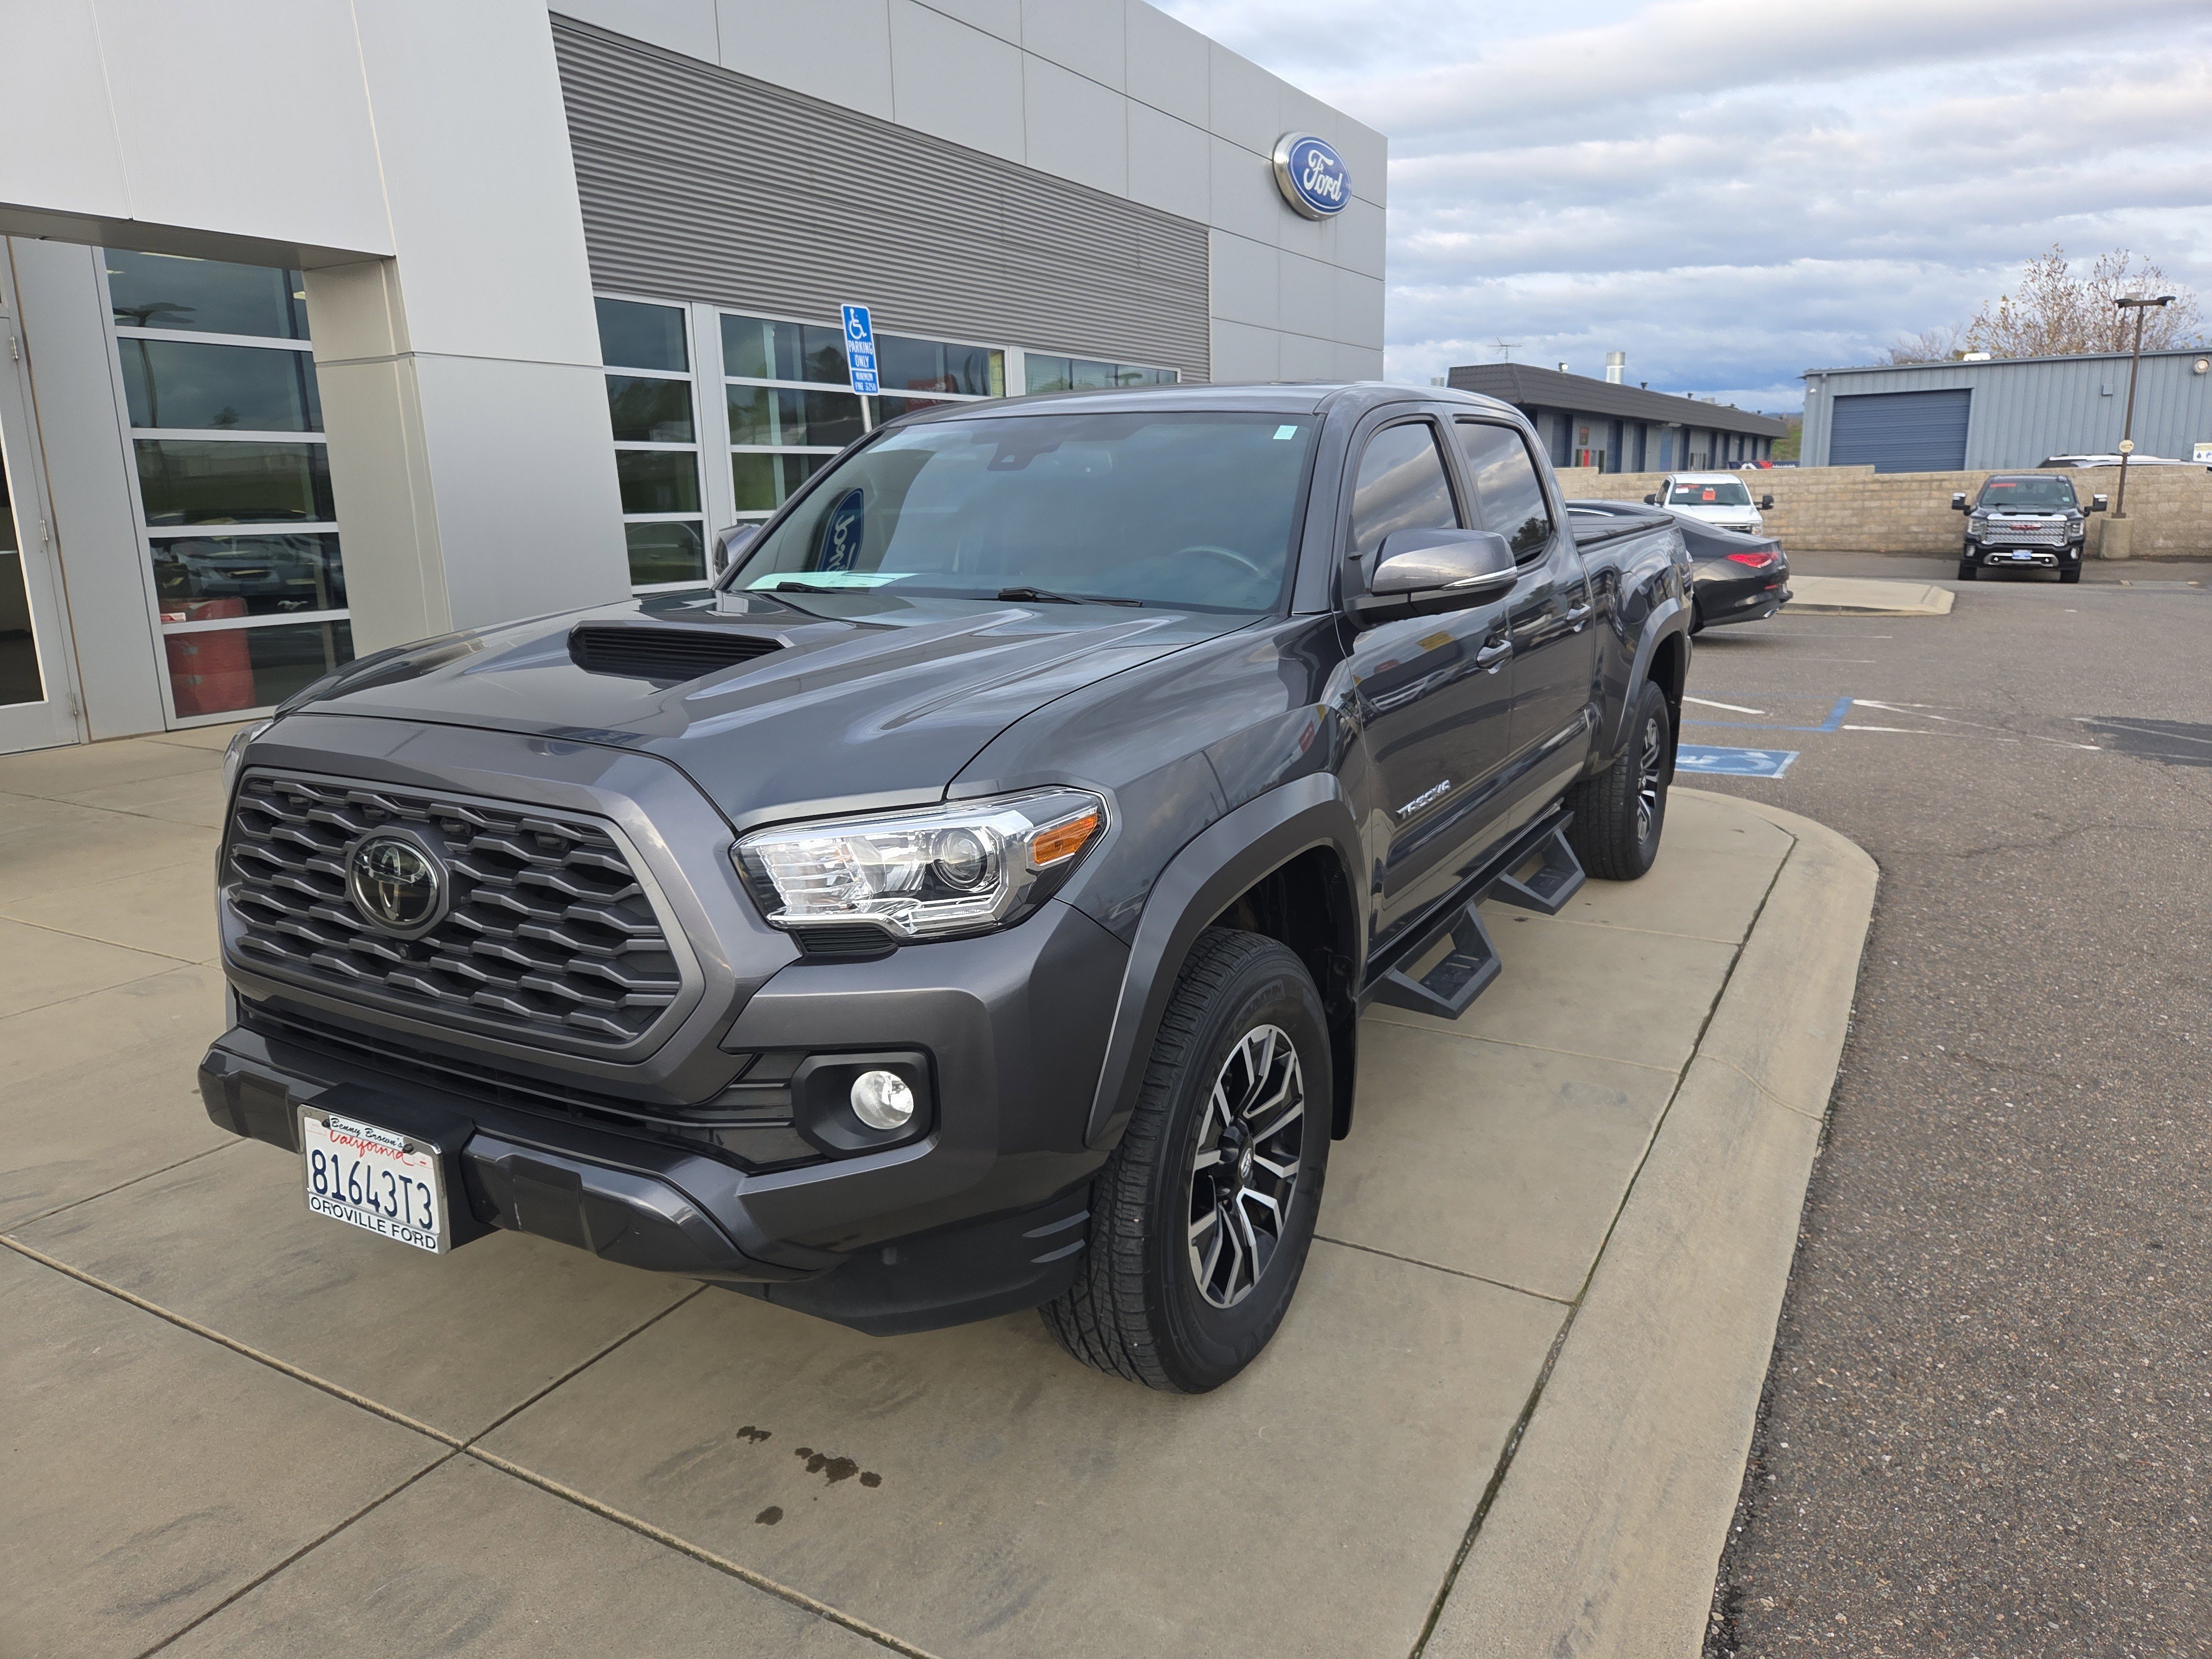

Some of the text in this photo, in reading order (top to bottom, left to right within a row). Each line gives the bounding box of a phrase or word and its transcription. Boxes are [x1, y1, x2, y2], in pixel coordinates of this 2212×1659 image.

[1303, 149, 1343, 202] Ford
[847, 340, 873, 355] PARKING
[854, 355, 870, 368] ONLY
[1395, 779, 1451, 820] TACOMA
[329, 1130, 414, 1167] California
[330, 1117, 403, 1148] Benny Brown's
[311, 1148, 433, 1231] 81643T3
[311, 1196, 437, 1250] OROVILLE FORD
